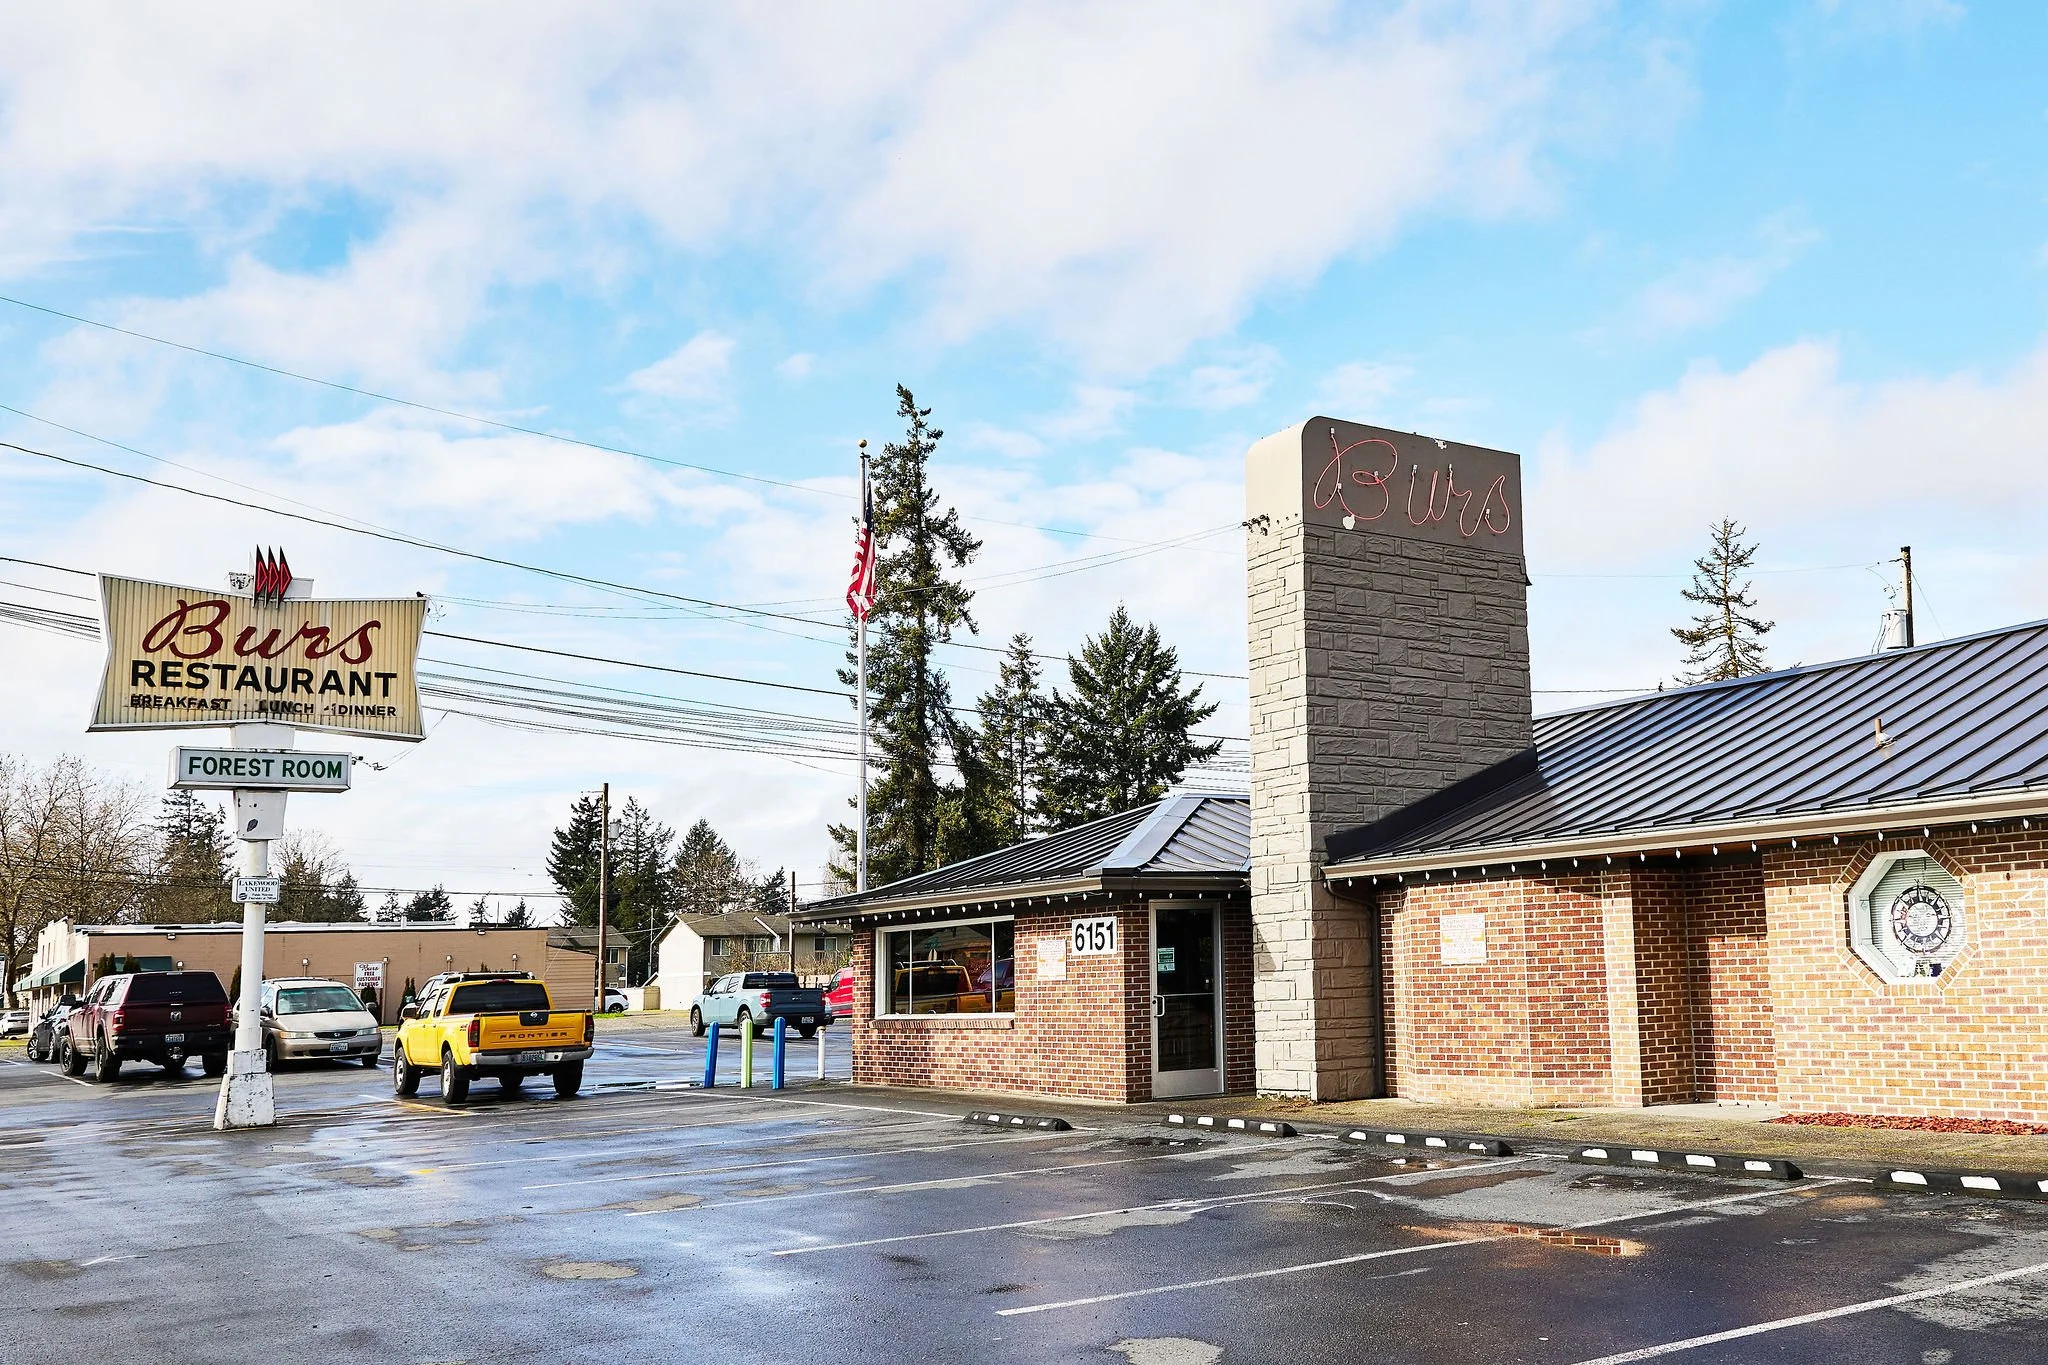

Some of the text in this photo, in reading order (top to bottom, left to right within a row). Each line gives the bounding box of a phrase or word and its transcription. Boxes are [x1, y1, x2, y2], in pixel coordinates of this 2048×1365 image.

[1313, 430, 1511, 537] Burs
[142, 599, 381, 665] Burs
[131, 660, 397, 698] RESTAURANT
[129, 694, 397, 717] BREAKFAST LUNCH DINNER
[188, 756, 343, 779] FOREST ROOM
[1075, 922, 1114, 951] 6151
